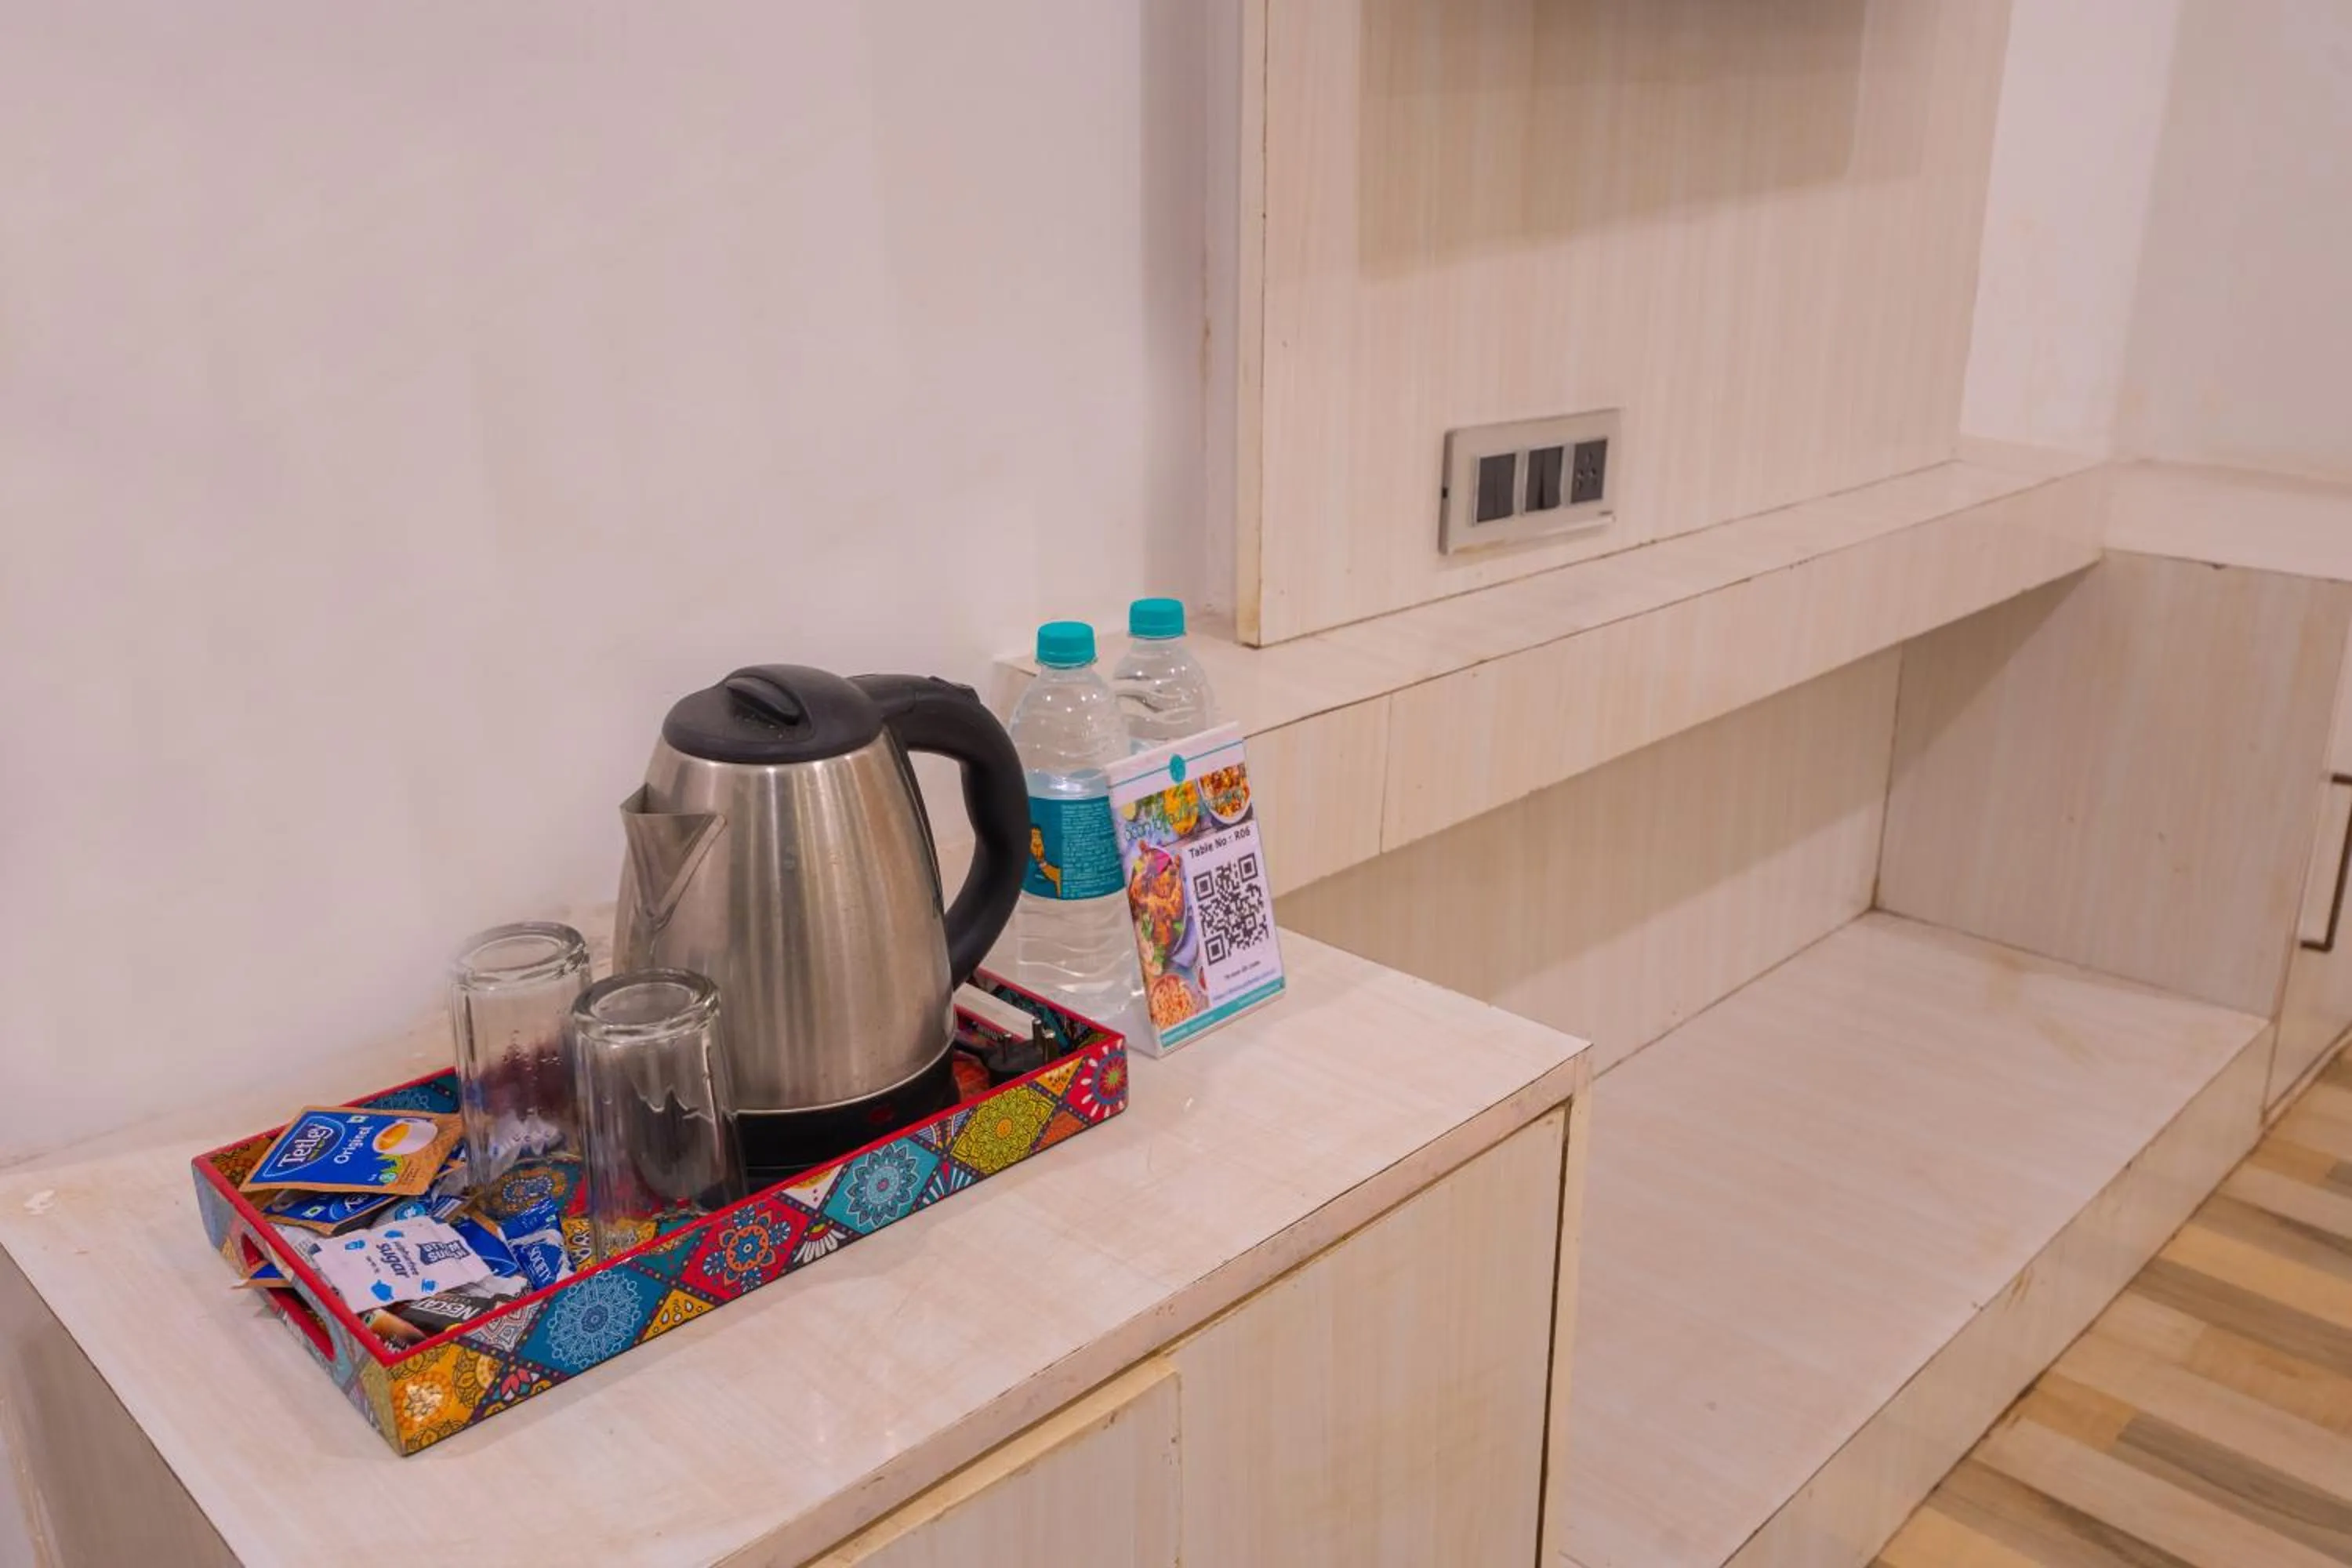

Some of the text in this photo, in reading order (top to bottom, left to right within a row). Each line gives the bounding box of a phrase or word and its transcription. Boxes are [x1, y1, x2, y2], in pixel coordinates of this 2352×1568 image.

[1189, 843, 1214, 859] Table
[1214, 837, 1227, 848] No
[277, 1123, 334, 1168] Tetley
[333, 1125, 375, 1165] Original
[376, 1243, 409, 1278] sugar
